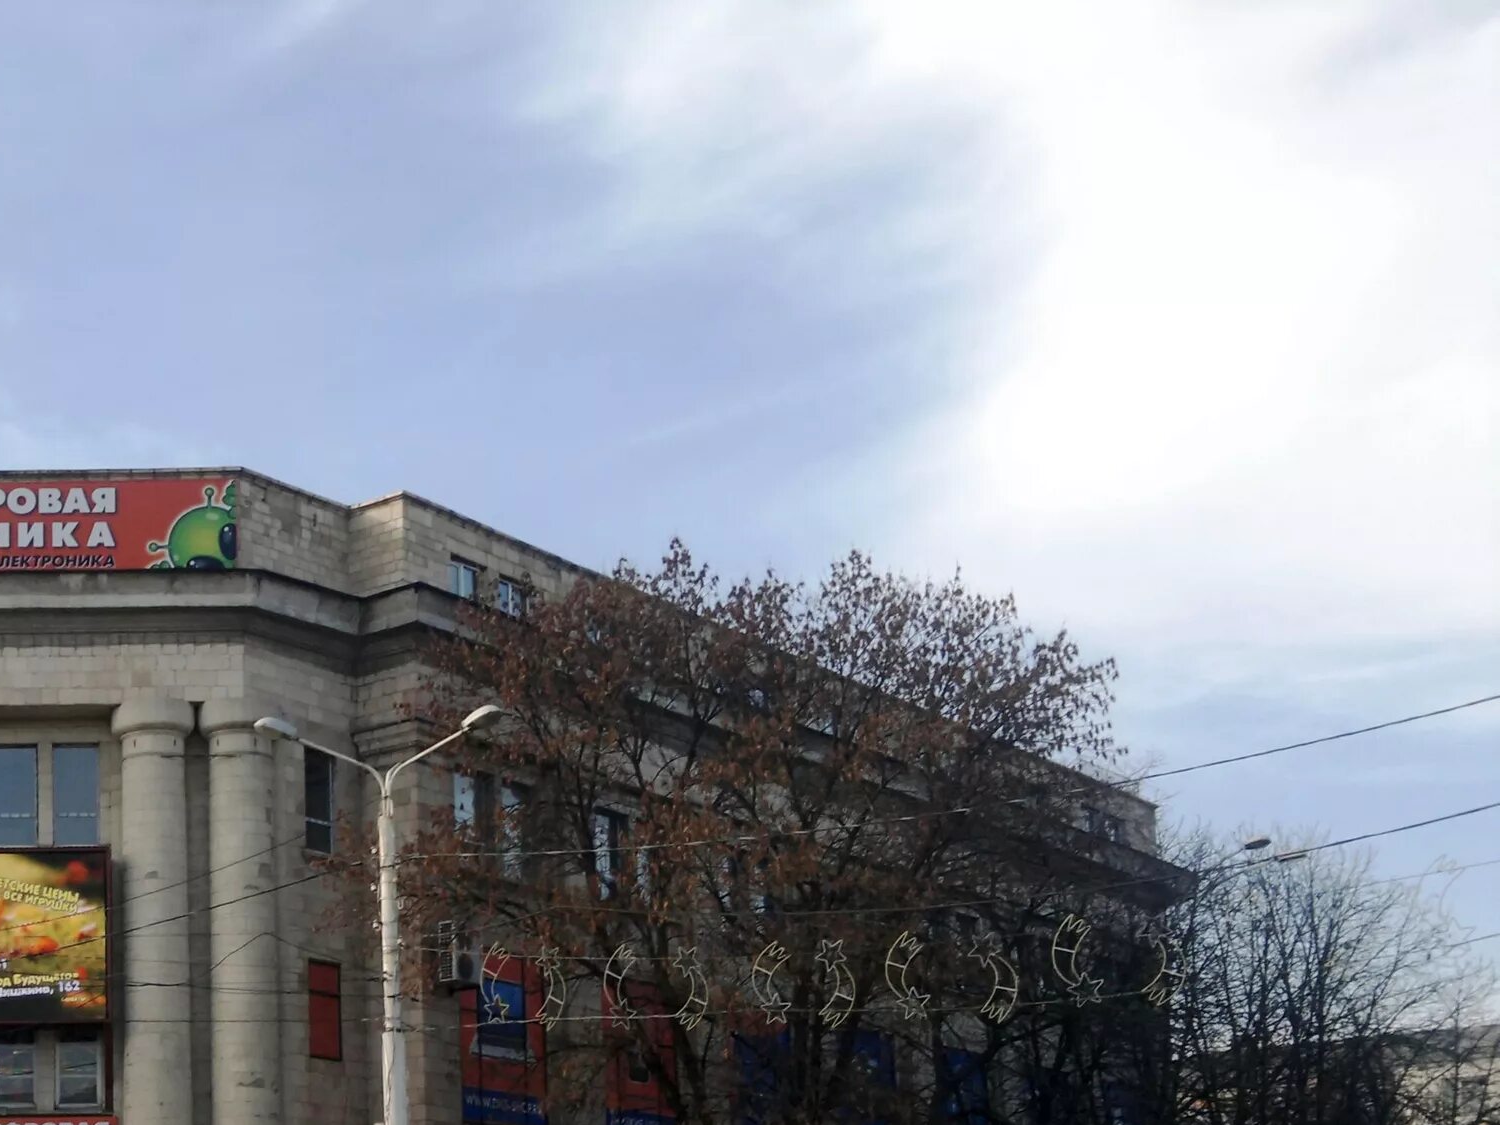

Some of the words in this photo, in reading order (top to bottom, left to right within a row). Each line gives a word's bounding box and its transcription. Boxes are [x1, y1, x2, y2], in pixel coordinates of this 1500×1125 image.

[3, 891, 25, 903] ВСЕ
[25, 895, 78, 914] ИГРУШКИ
[41, 886, 80, 903] ЦЕНЫ
[58, 980, 81, 993] 162
